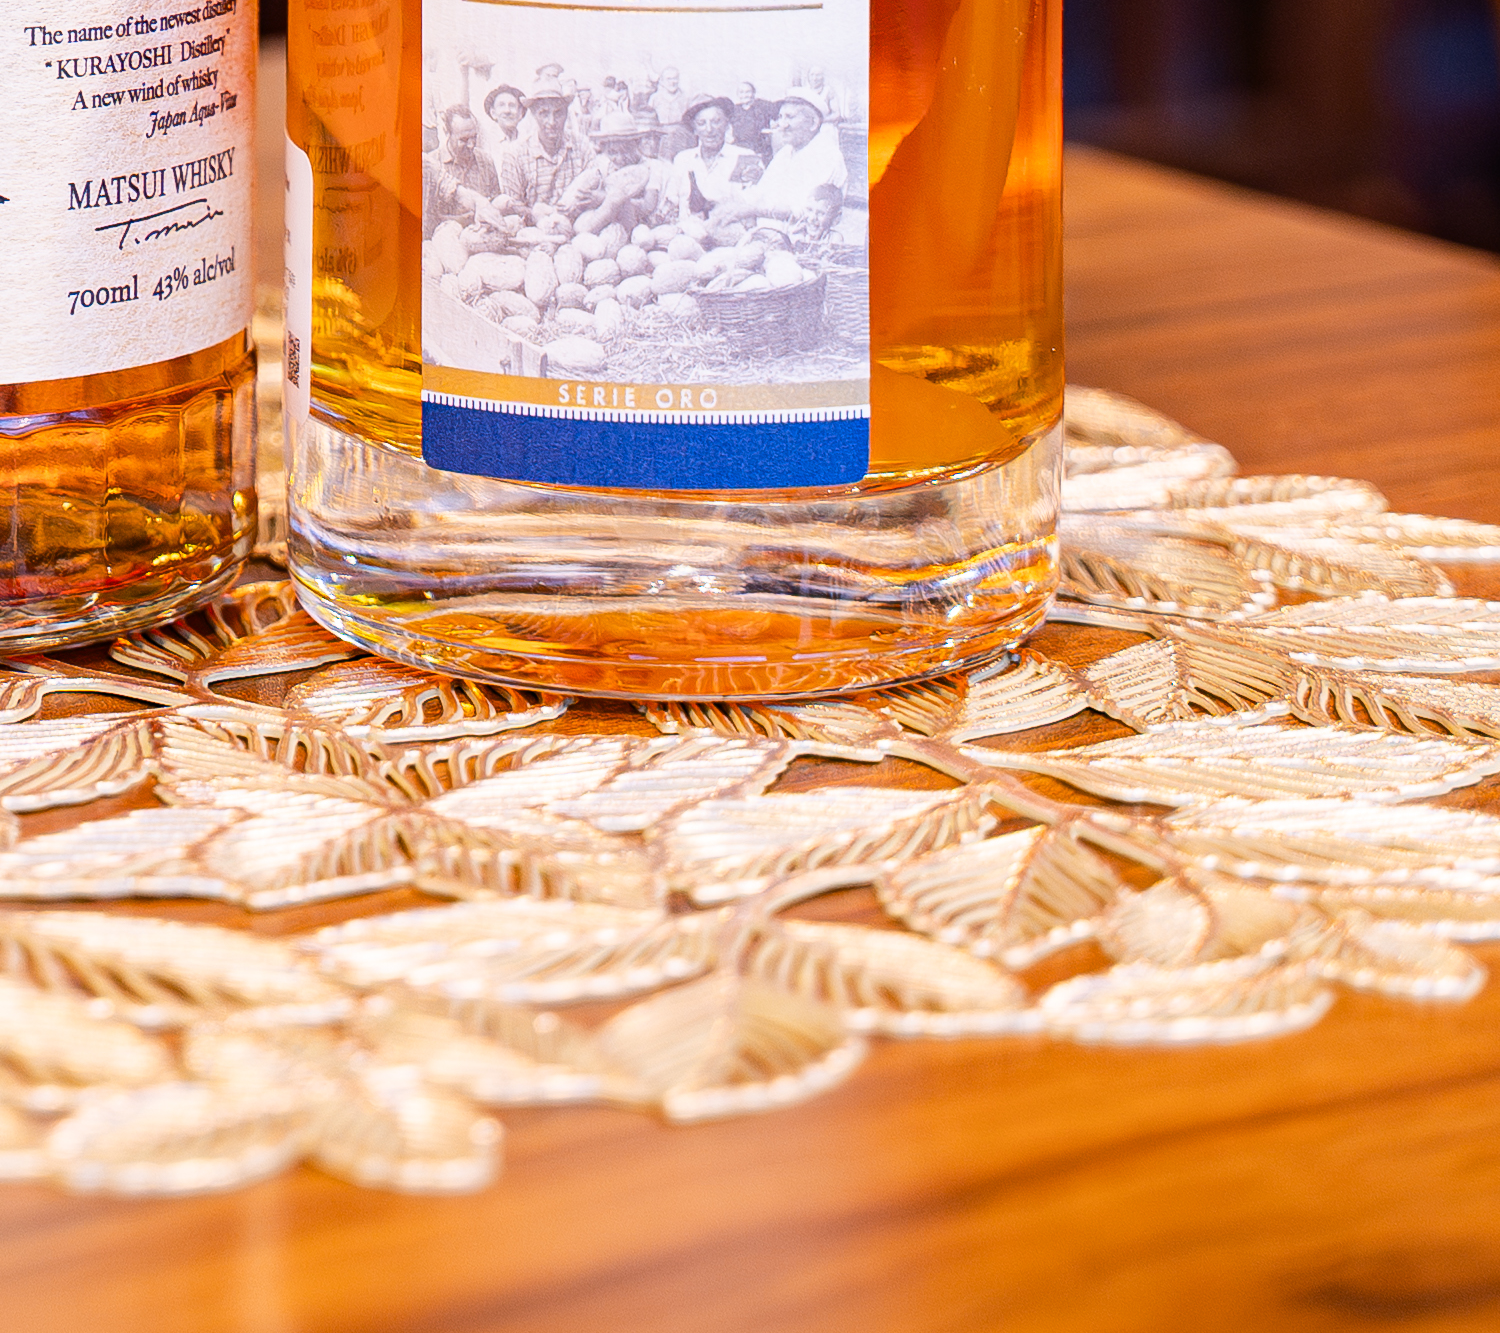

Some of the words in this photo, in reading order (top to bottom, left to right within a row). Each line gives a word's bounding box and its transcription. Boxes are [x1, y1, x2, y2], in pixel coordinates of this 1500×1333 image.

[24, 25, 63, 46] The
[67, 25, 113, 44] name
[116, 16, 134, 38] of
[134, 14, 158, 35] the
[160, 7, 201, 32] newest
[71, 90, 89, 111] A
[92, 91, 126, 109] new
[128, 78, 164, 103] wind
[167, 74, 183, 97] of
[182, 67, 219, 92] whisky
[146, 110, 187, 139] Japan
[67, 168, 166, 210] MATSUI
[171, 146, 236, 194] WHISKY
[67, 274, 139, 315] 700ml
[152, 265, 189, 301] 43%
[193, 246, 236, 286] alc/vol
[558, 384, 636, 408] SERIE
[655, 388, 717, 409] ORO
